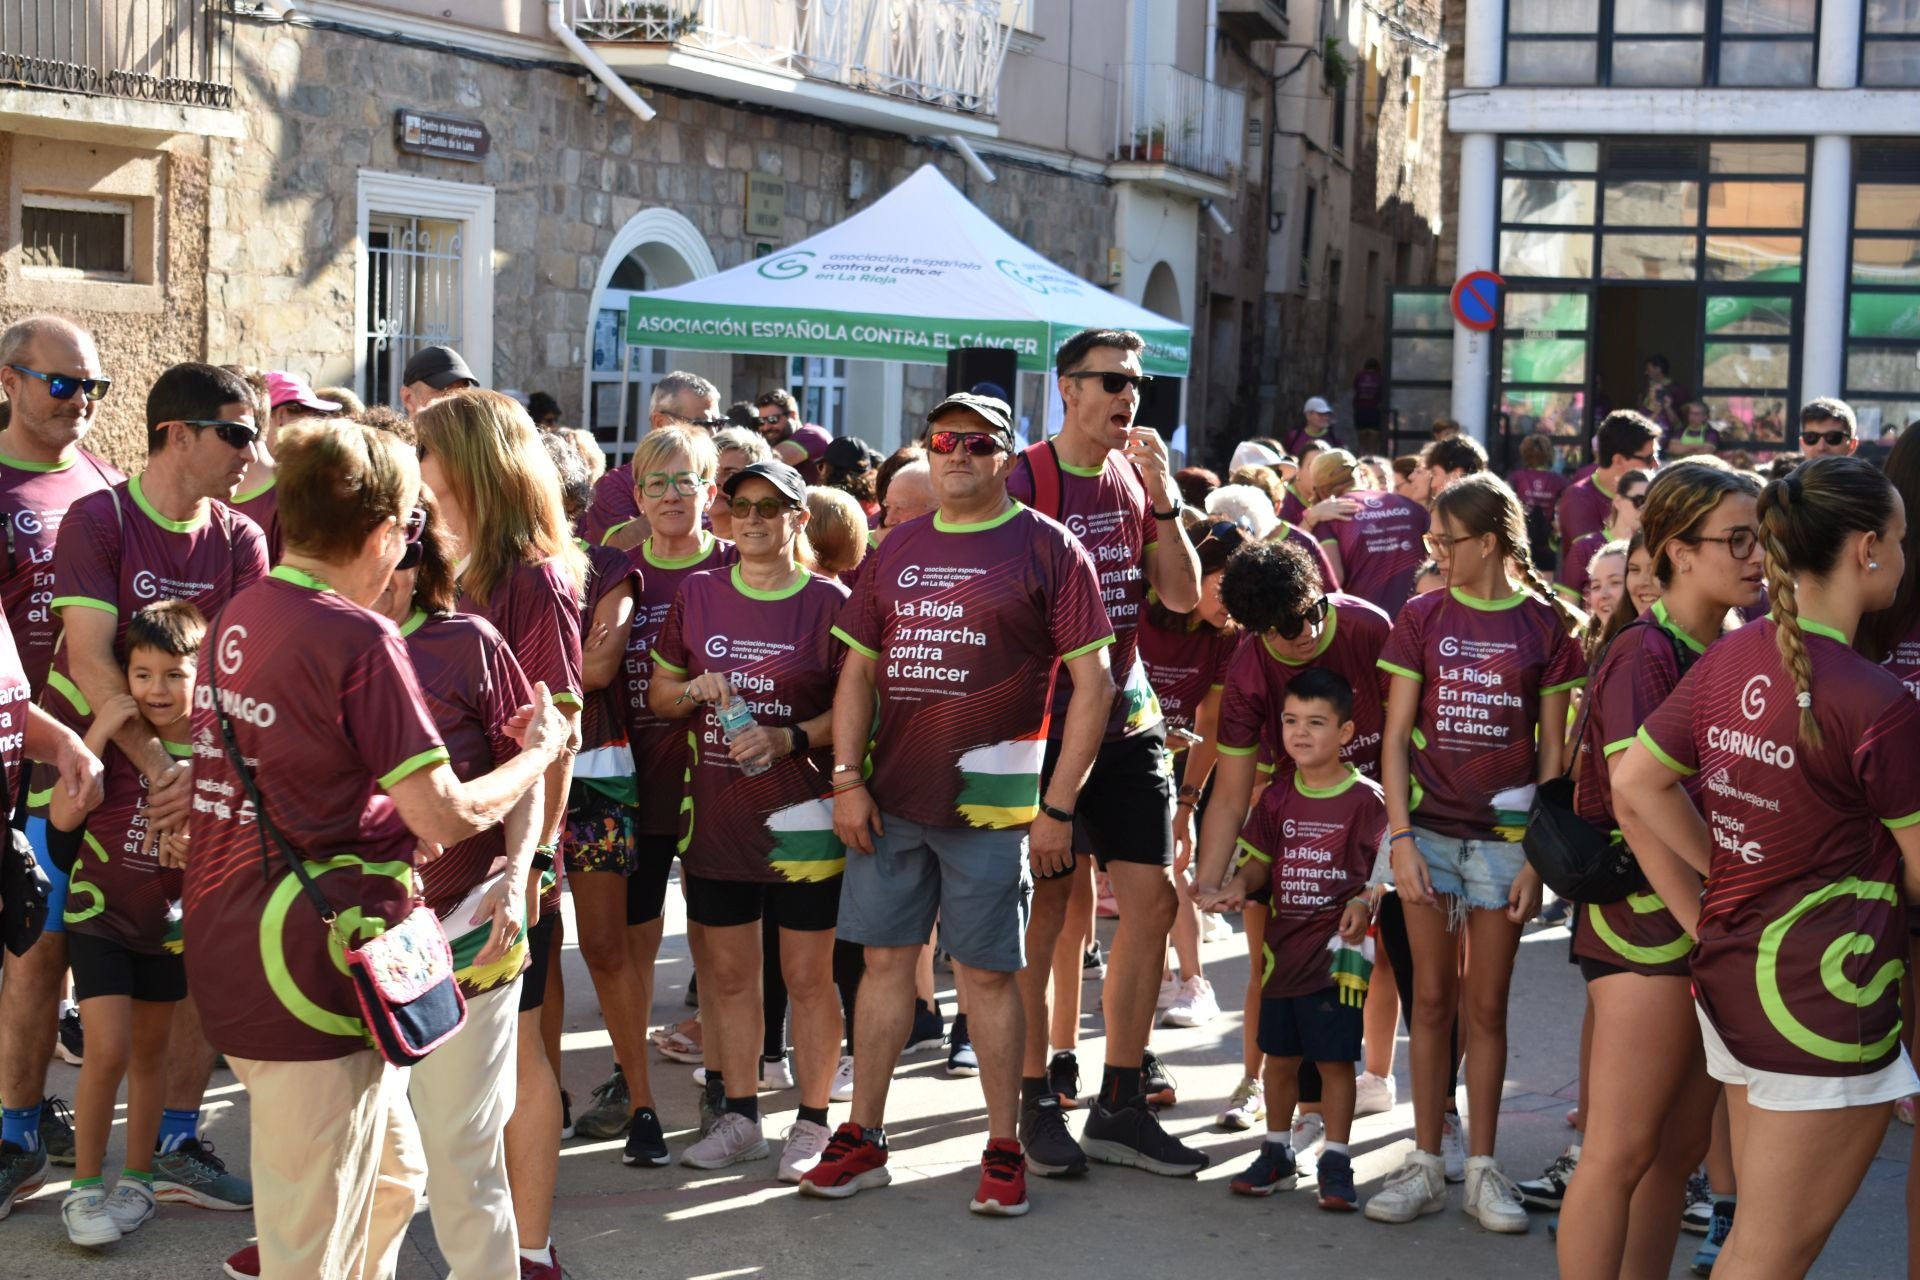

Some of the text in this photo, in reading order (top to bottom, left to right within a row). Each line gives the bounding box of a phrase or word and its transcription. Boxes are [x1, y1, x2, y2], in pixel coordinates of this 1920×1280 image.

[822, 263, 944, 277] contra el cáncer
[829, 253, 982, 271] asociación española
[815, 272, 897, 284] en La Rioja
[637, 316, 748, 337] ASOCIACIÓN
[752, 319, 848, 341] ESPAÑOLA
[851, 325, 929, 347] CONTRA
[933, 333, 956, 350] EL
[959, 333, 1038, 355] CÁNCER
[1354, 507, 1410, 520] CORNAGO
[30, 548, 53, 564] La
[1098, 543, 1132, 562] Rioja
[958, 567, 987, 575] española
[34, 572, 55, 587] En
[938, 580, 954, 588] Rioja
[1101, 586, 1126, 600] ntra
[28, 608, 49, 622] el
[895, 600, 963, 620] La Rioja
[1106, 603, 1138, 617] áncer
[914, 626, 986, 646] marcha
[766, 643, 795, 651] española
[890, 643, 942, 660] contra
[748, 654, 764, 662] Rioja
[626, 660, 648, 674] En
[887, 661, 970, 683] el cáncer
[730, 672, 774, 694] Rioja
[1440, 665, 1502, 688] La Rioja
[0, 684, 31, 706] arch
[631, 693, 646, 708] el
[1159, 694, 1182, 710] oja
[1438, 686, 1522, 708] En marcha
[747, 698, 792, 717] archa
[1437, 704, 1489, 720] contra
[1436, 718, 1510, 737] el cáncer
[704, 729, 718, 744] el
[1338, 732, 1380, 758] archa
[1707, 725, 1795, 770] CORNAGO
[131, 814, 149, 828] En
[124, 841, 138, 854] el
[1284, 847, 1332, 863] La Rioja
[1282, 864, 1347, 880] En marcha
[1280, 880, 1320, 892] contra
[1281, 892, 1334, 905] el cánce
